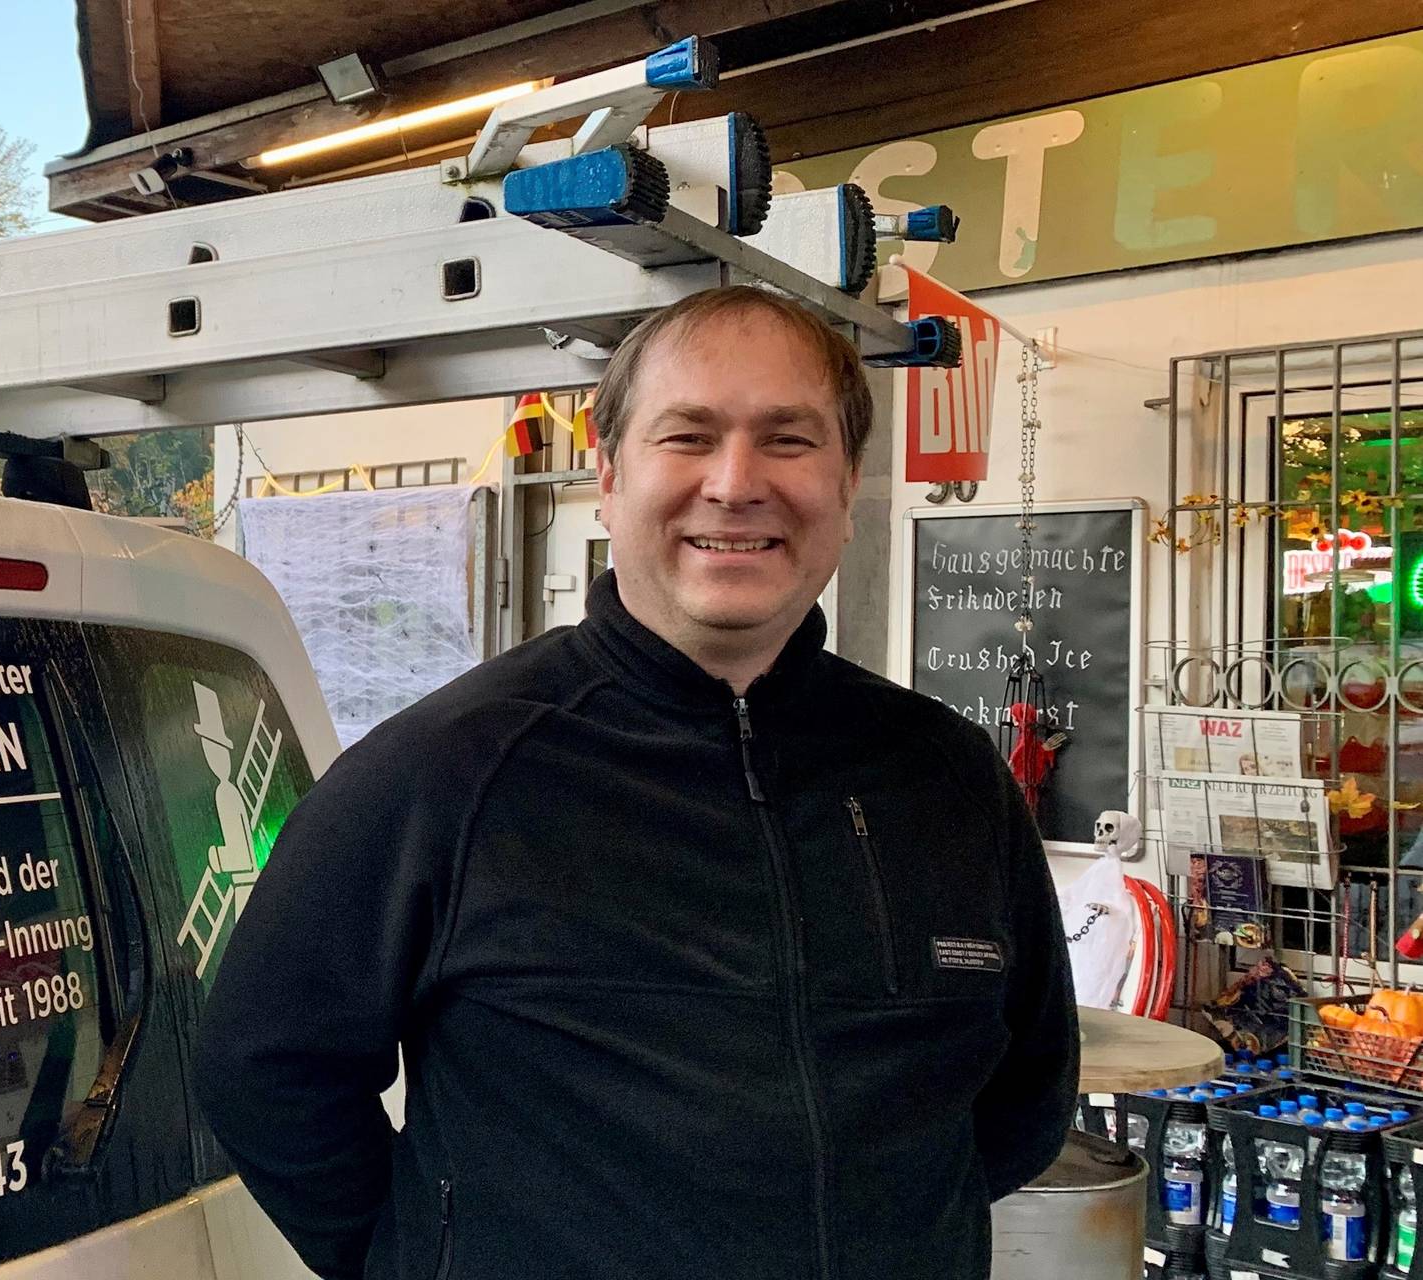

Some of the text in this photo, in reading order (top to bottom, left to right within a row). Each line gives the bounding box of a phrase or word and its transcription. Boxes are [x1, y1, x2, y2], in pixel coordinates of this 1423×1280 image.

[772, 45, 1423, 298] STER
[927, 582, 1063, 611] Frikadelen
[1046, 640, 1093, 670] Ice
[1199, 719, 1242, 737] WAZ
[18, 853, 59, 890] der
[24, 971, 85, 1020] 1988
